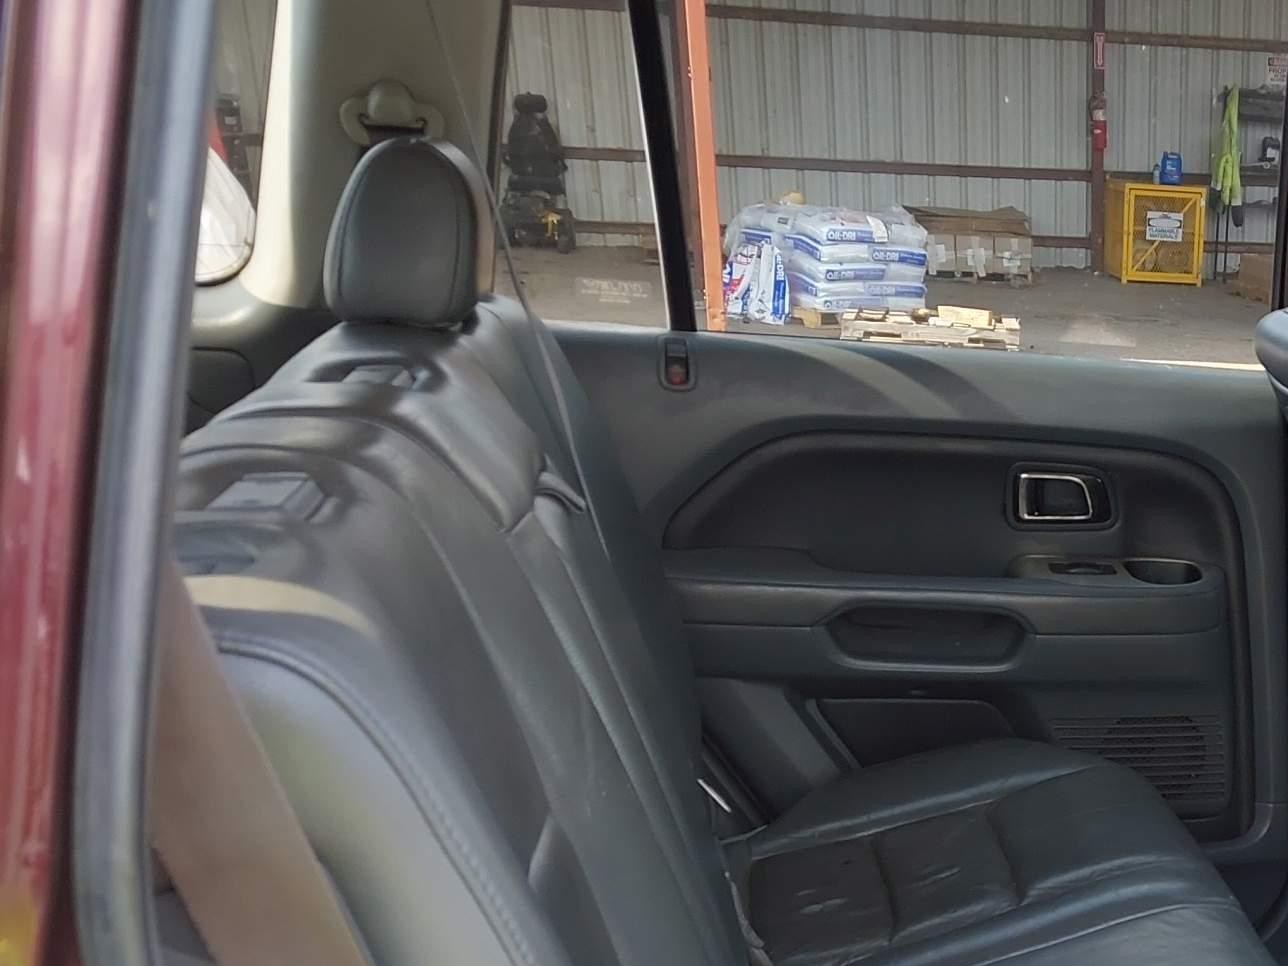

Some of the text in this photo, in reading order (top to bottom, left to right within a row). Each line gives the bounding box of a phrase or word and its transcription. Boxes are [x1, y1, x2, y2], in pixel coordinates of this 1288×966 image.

[827, 230, 857, 241] OIL-DRI
[872, 250, 899, 262] OIL-DRI
[826, 270, 855, 281] OIL-DRI
